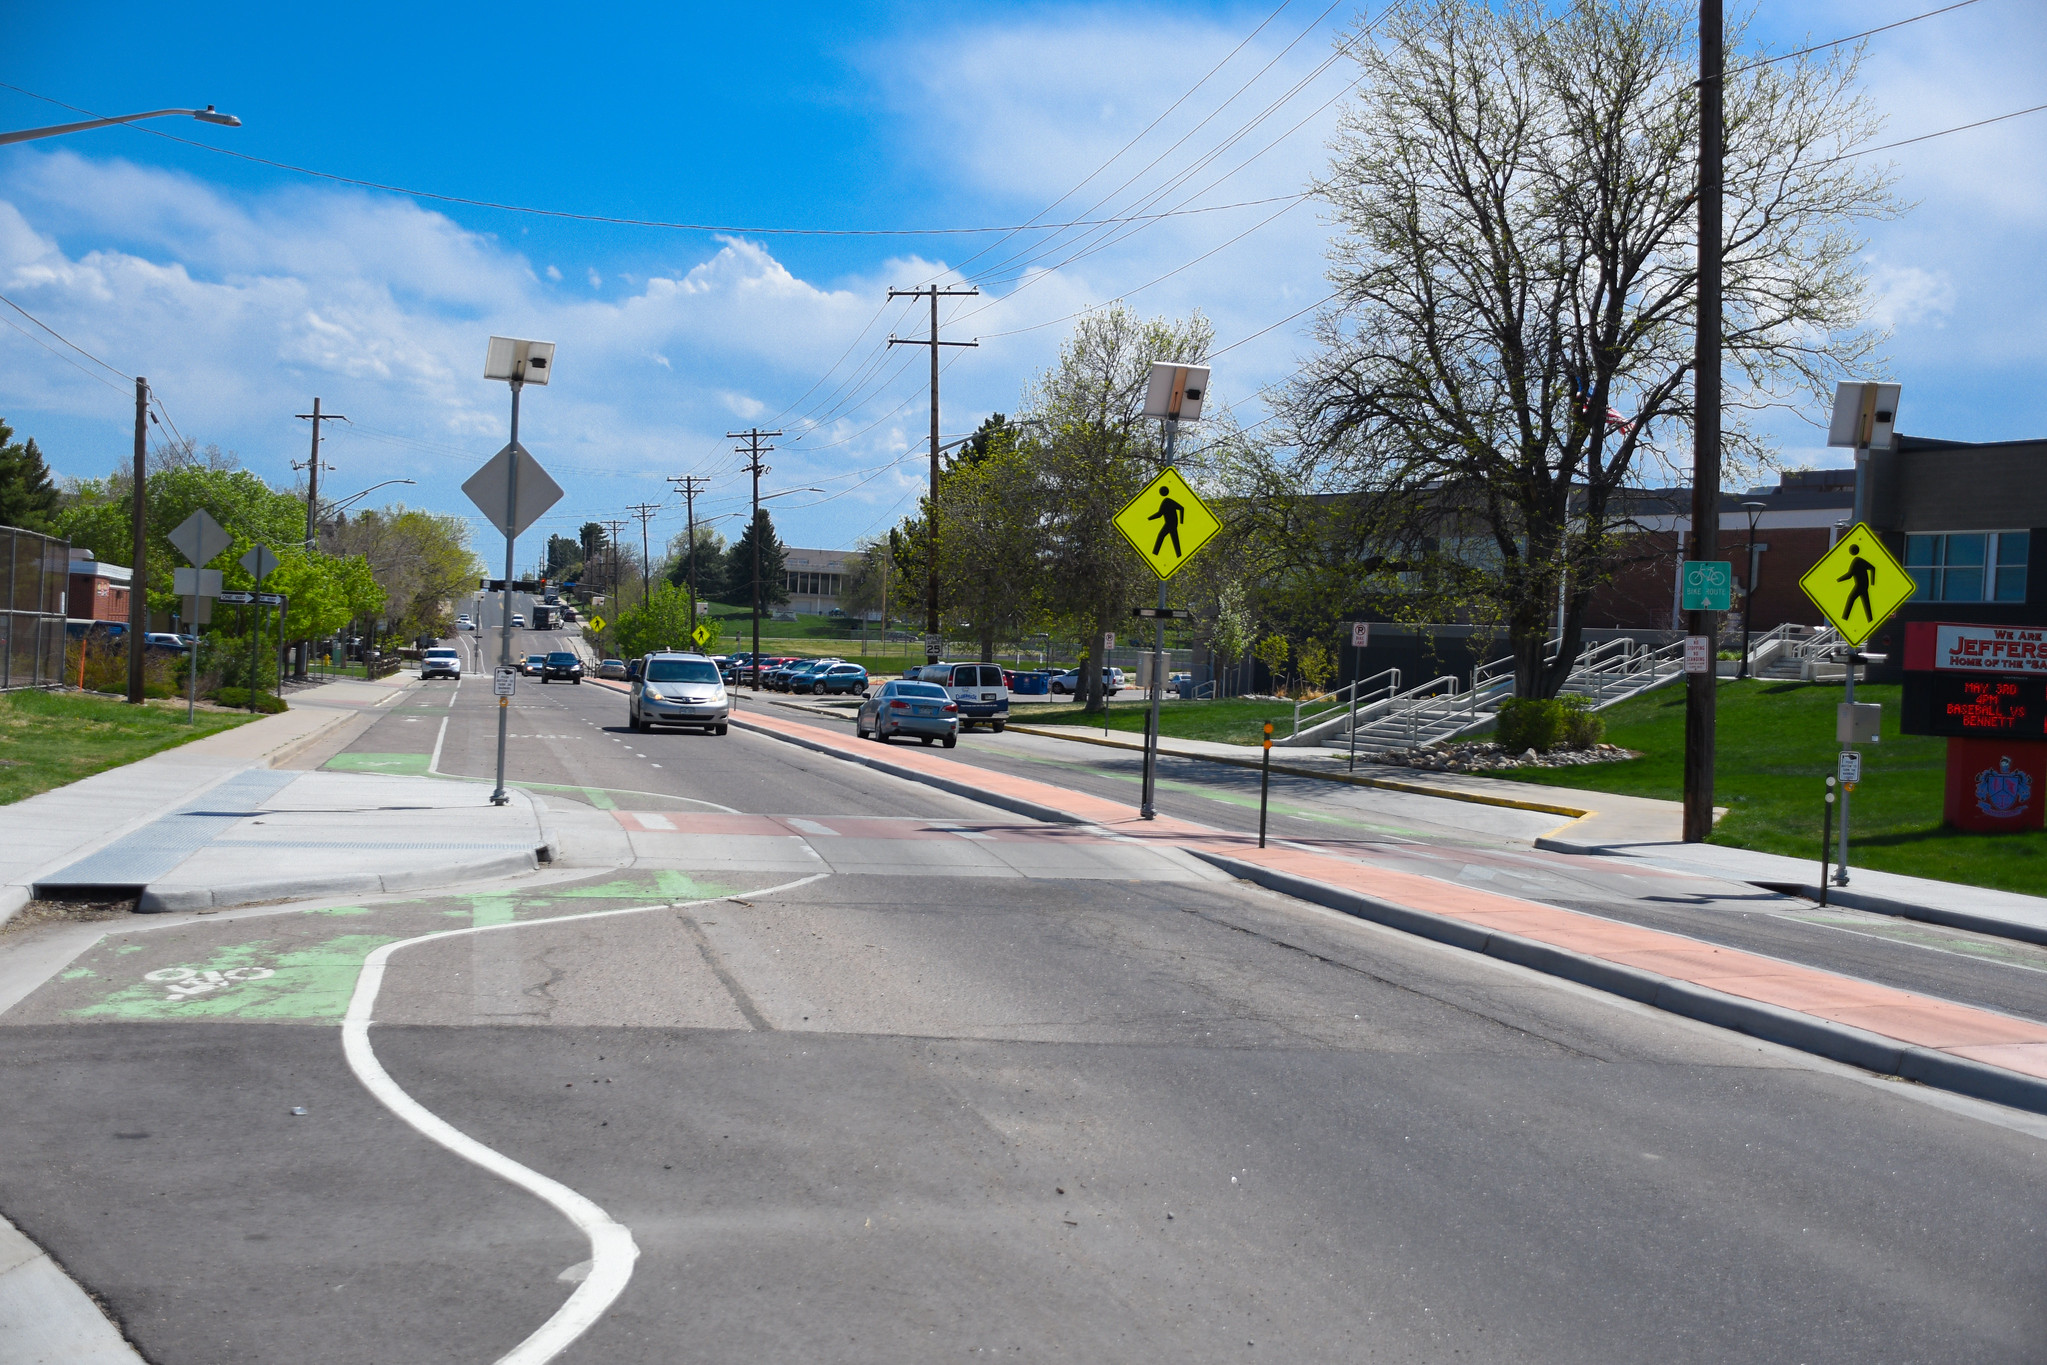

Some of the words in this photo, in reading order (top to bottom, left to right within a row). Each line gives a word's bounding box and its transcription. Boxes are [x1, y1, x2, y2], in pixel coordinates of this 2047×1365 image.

[1993, 629, 2014, 640] WE
[2018, 631, 2042, 641] ARE
[926, 645, 941, 654] 25
[1950, 656, 1982, 667] HOME
[1984, 658, 1999, 668] OF
[2001, 659, 2023, 668] THE
[1965, 682, 1989, 693] MAY
[1996, 683, 2017, 695] 3RD
[1975, 694, 1999, 704] 4PM
[1946, 703, 2003, 717] BASEBALL
[2009, 706, 2025, 717] VS
[1963, 715, 2015, 728] BENNETT
